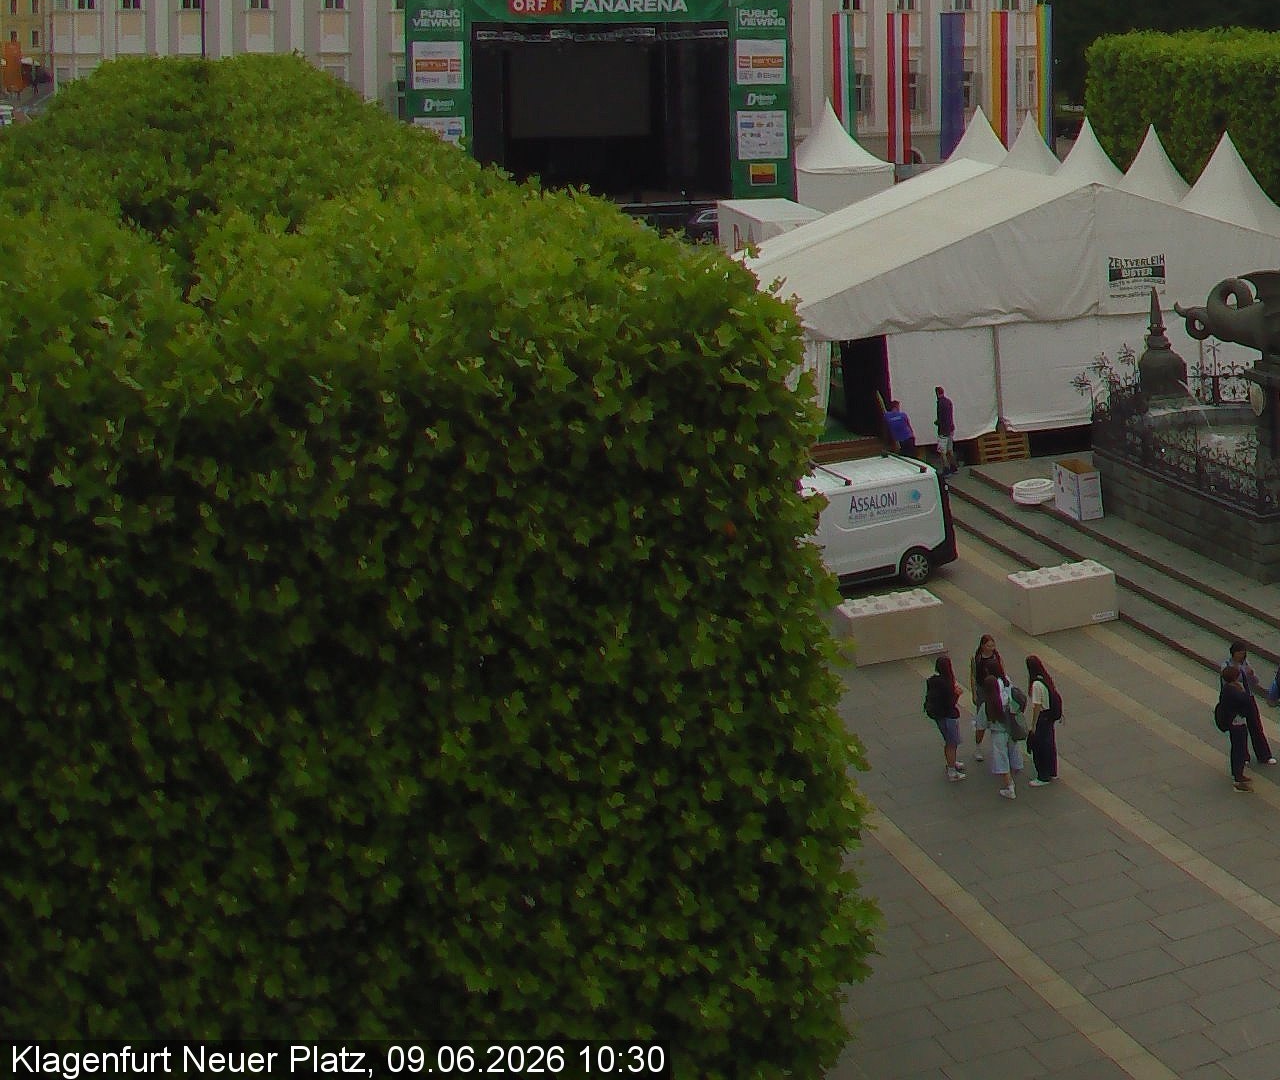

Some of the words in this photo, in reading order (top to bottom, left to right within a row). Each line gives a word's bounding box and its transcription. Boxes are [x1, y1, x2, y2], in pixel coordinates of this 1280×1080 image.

[553, 0, 562, 11] K
[419, 9, 461, 18] PUBLIC
[739, 9, 779, 18] PUBLIC
[411, 18, 461, 27] VIEWING
[739, 17, 786, 26] VIEWING
[1108, 253, 1165, 269] ZELTVERLEIH
[850, 491, 897, 513] ASSALONI
